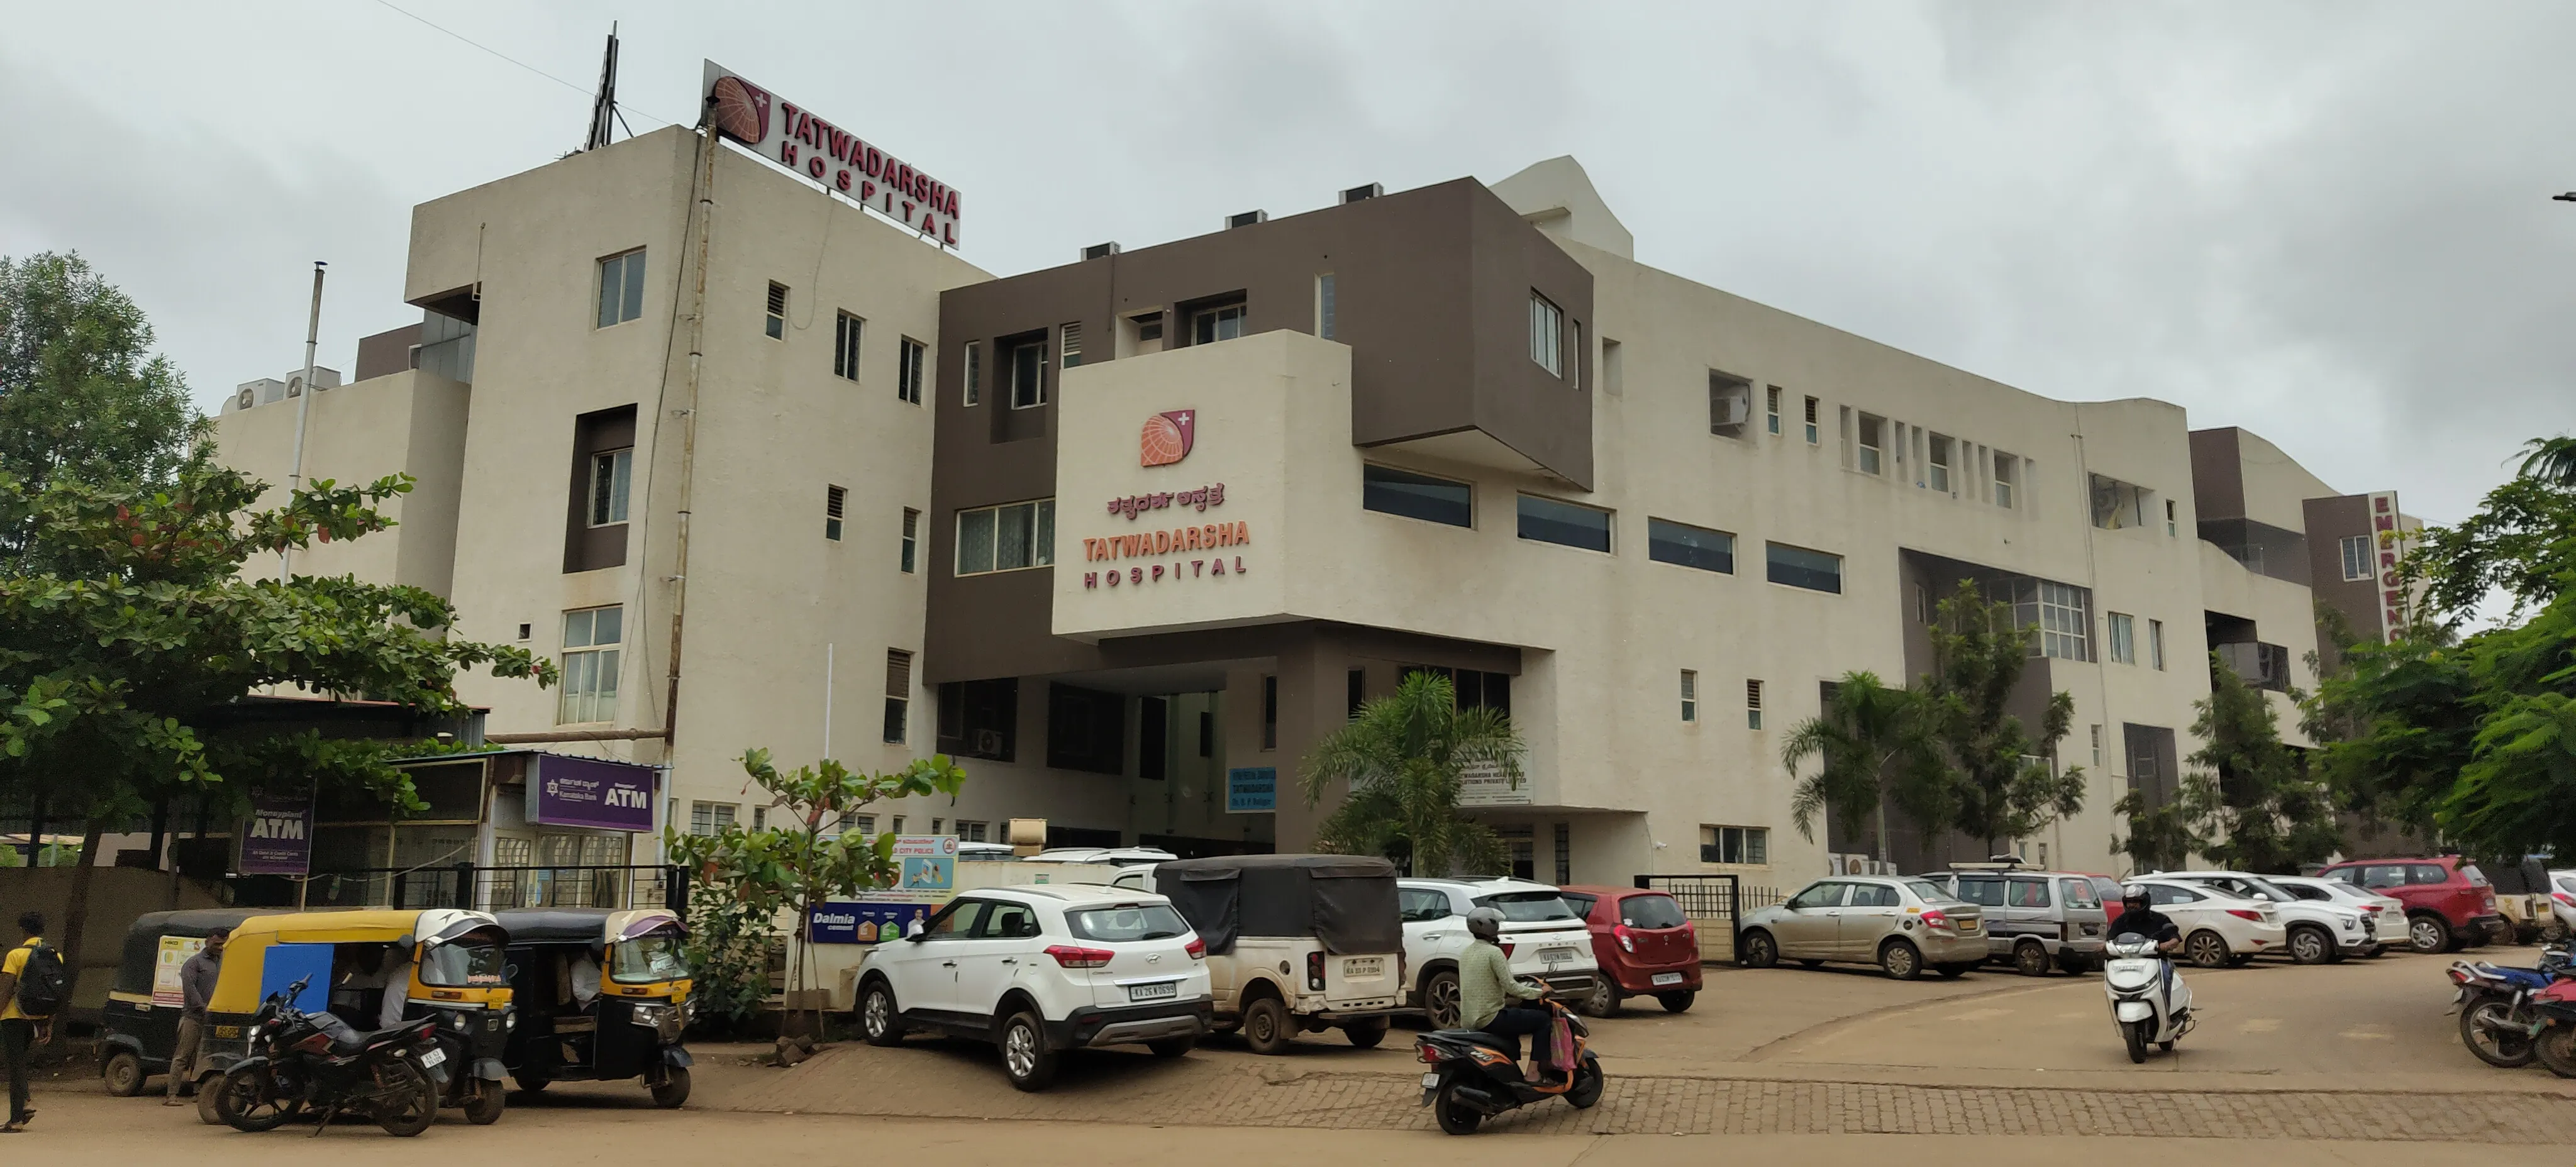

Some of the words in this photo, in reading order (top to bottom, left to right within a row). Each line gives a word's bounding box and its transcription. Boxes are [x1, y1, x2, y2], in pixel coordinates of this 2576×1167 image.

[781, 102, 960, 220] TATWADARSHA
[781, 140, 956, 245] HOSPITAL
[1083, 521, 1250, 561] TATWADARSHA
[1084, 556, 1246, 589] HOSPITAL
[604, 788, 647, 809] ATM
[250, 818, 304, 840] ATM
[813, 912, 855, 924] Dalmia
